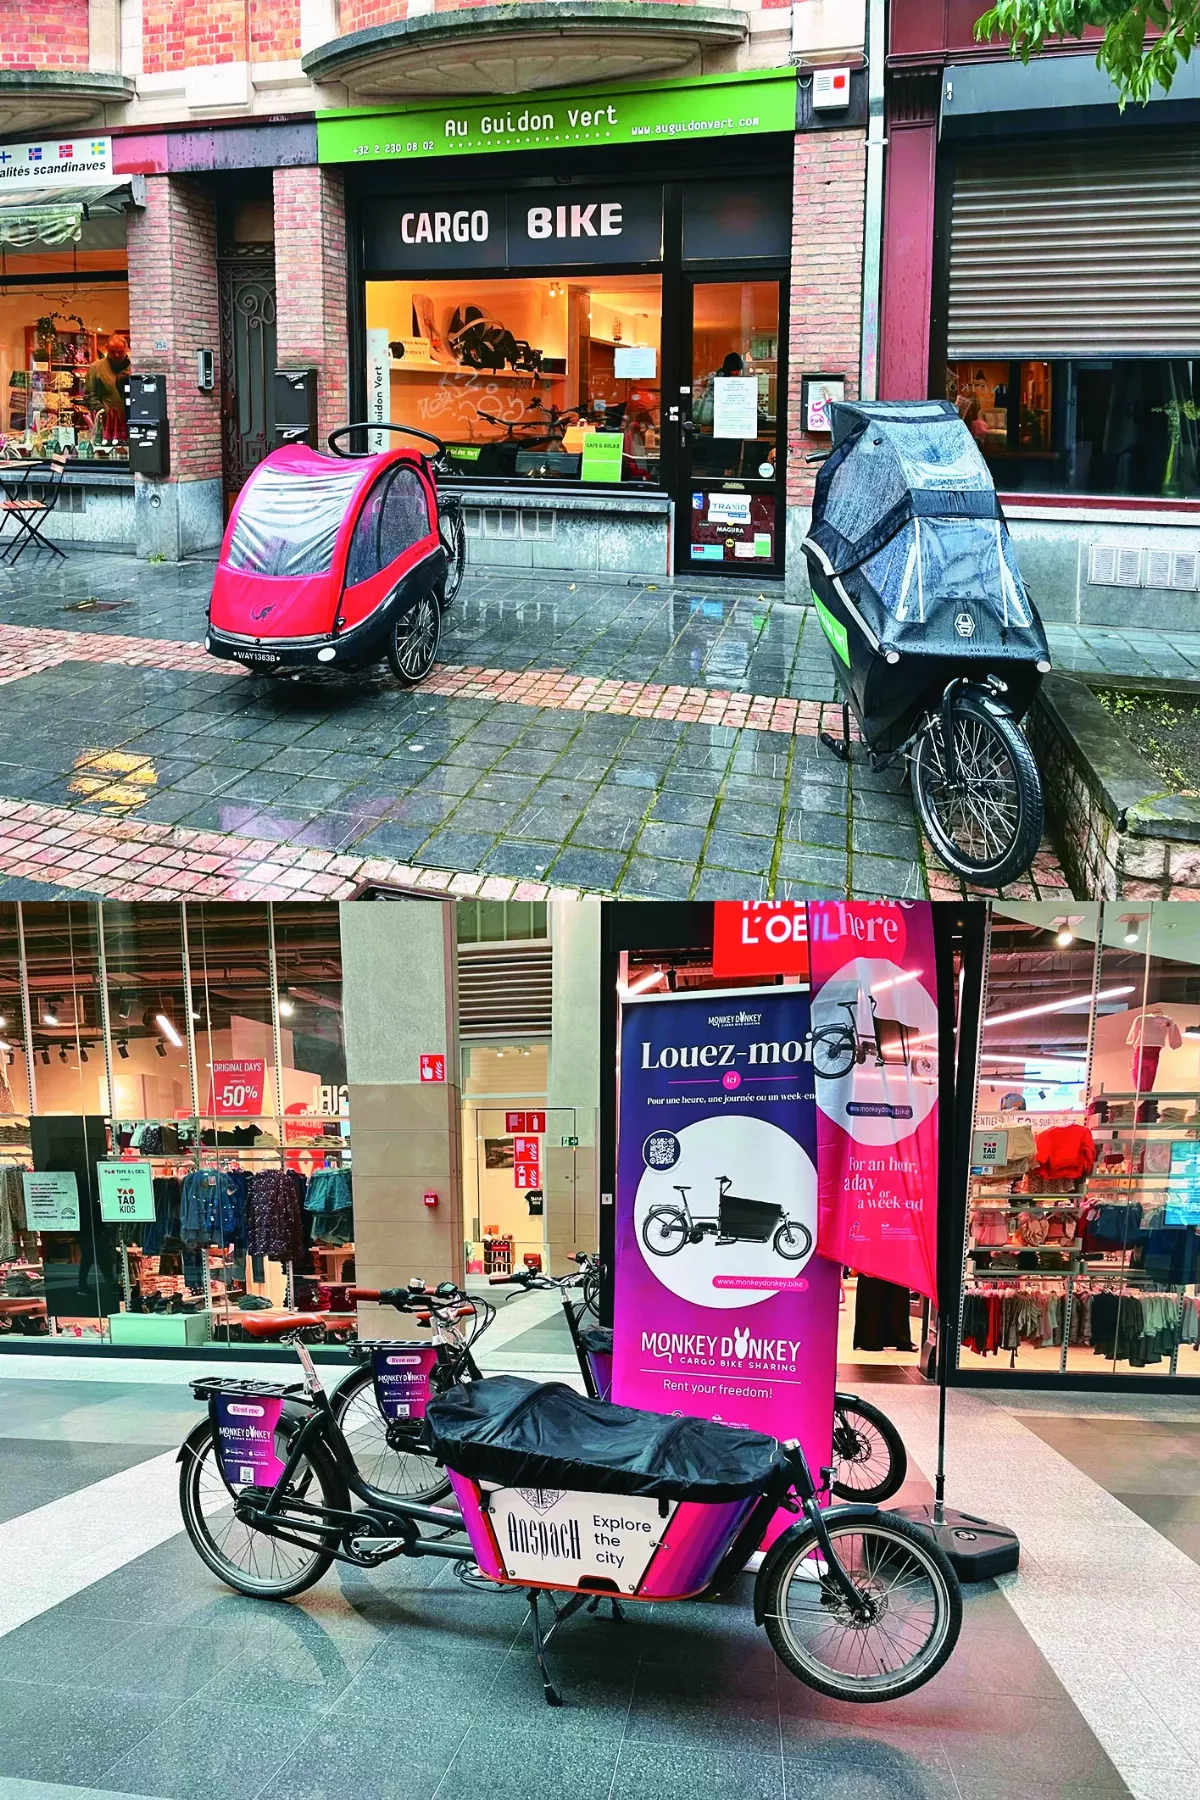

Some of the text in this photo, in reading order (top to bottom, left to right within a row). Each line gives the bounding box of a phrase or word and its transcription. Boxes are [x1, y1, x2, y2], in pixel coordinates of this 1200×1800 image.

[445, 105, 619, 137] Au Guidon Vert
[631, 117, 759, 136] www.auguidonvert.com
[353, 145, 369, 155] +32
[374, 145, 380, 154] 2
[385, 144, 401, 153] 230
[423, 141, 434, 151] 02
[33, 160, 106, 176] scandinaves
[401, 202, 623, 244] CARGO BIKE
[155, 341, 167, 349] 354
[374, 366, 384, 447] Au uidon Vert
[716, 526, 744, 534] MAGURA
[839, 902, 898, 944] here
[641, 1031, 813, 1070] Louez-moi
[213, 1063, 243, 1072] ORIGINAL
[726, 1075, 737, 1083] ici
[647, 1097, 665, 1105] Pour
[681, 1095, 706, 1104] heure,
[722, 1094, 755, 1105] journée
[780, 1092, 816, 1101] week-en
[850, 1156, 865, 1172] For
[868, 1160, 885, 1171] an
[844, 1174, 878, 1195] a day
[117, 1195, 136, 1205] TAO
[879, 1190, 891, 1199] or
[119, 1205, 136, 1214] KIDS
[858, 1199, 864, 1209] a
[717, 1278, 803, 1289] www.monkeydonkey.bike
[641, 1331, 718, 1364] MONKEY
[680, 1356, 797, 1373] CARGO BIKE SHARING
[663, 1379, 773, 1399] Rent your freedom!
[232, 1405, 247, 1414] Rent
[219, 1427, 245, 1440] MONKEY
[593, 1515, 652, 1533] Explore
[594, 1533, 621, 1547] the
[596, 1552, 625, 1568] city
